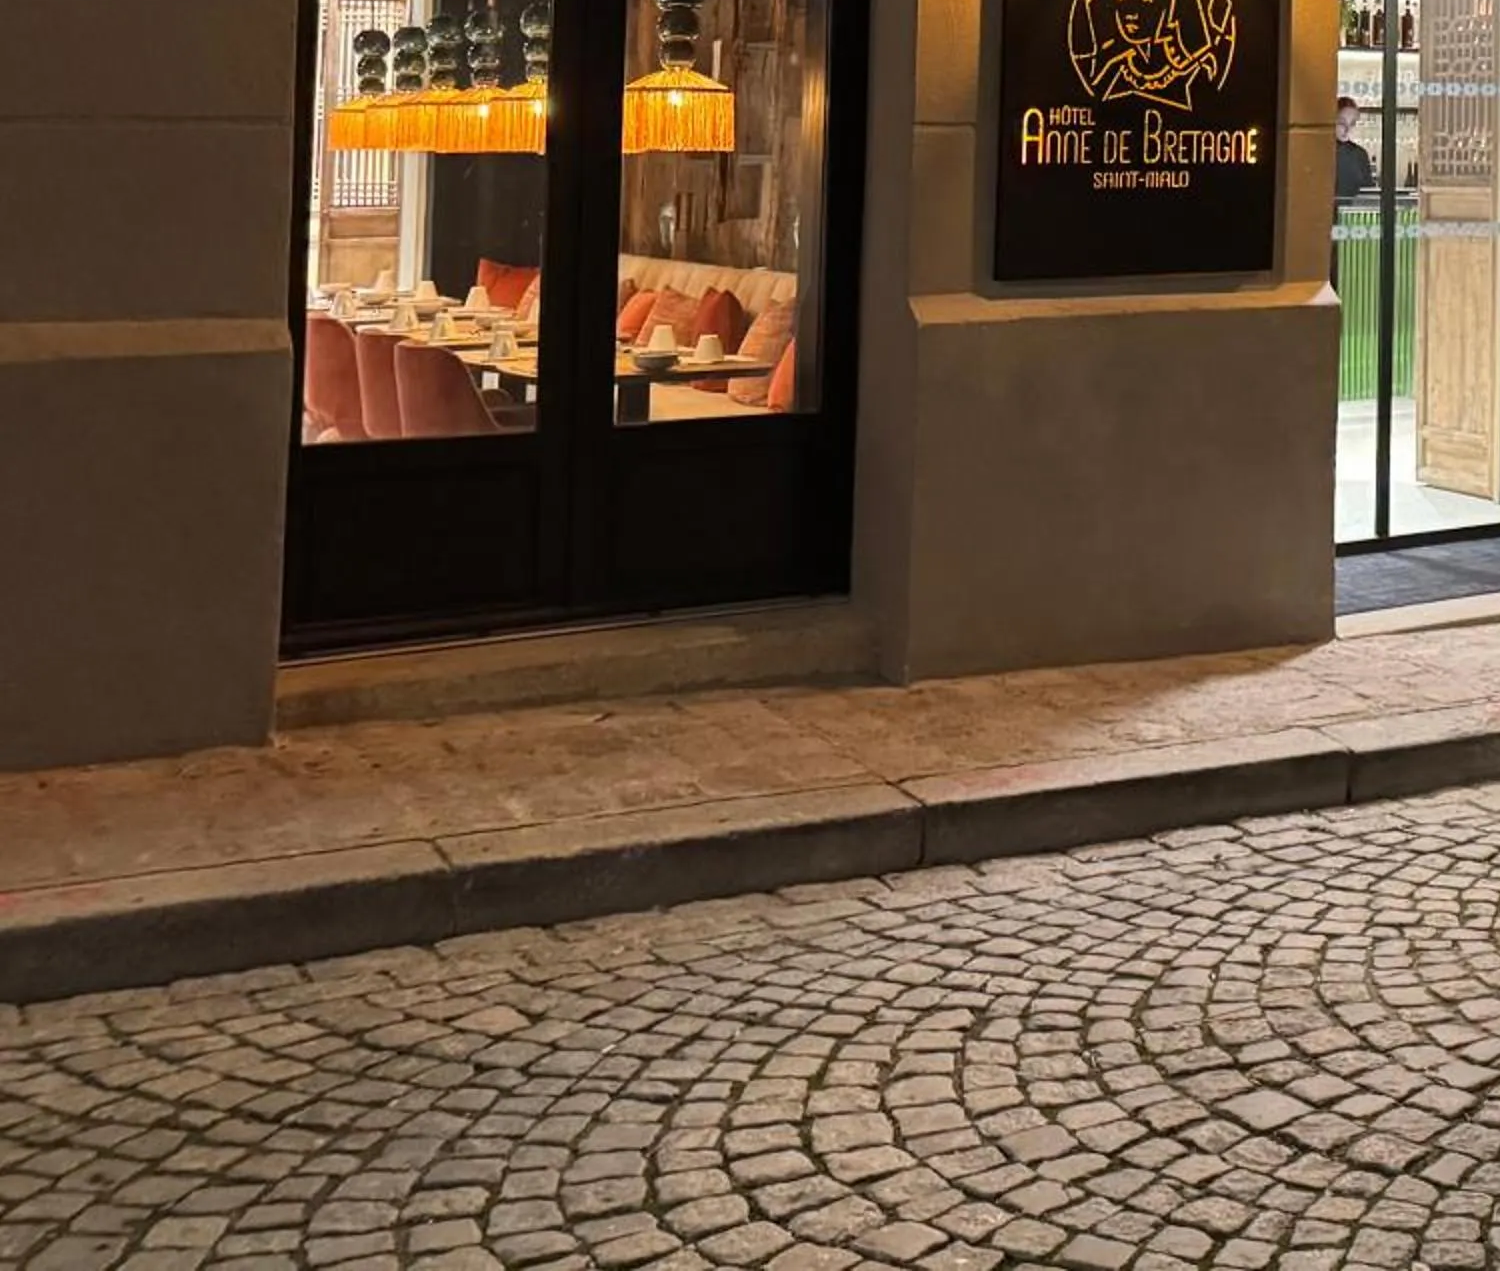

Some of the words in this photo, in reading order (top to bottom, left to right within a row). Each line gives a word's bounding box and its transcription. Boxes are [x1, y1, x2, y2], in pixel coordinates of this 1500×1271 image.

[1049, 104, 1096, 126] HÔTEL
[1103, 130, 1132, 164] DE
[1143, 109, 1258, 165] BRETAGNE
[1093, 171, 1189, 189] SAINT-MALO
